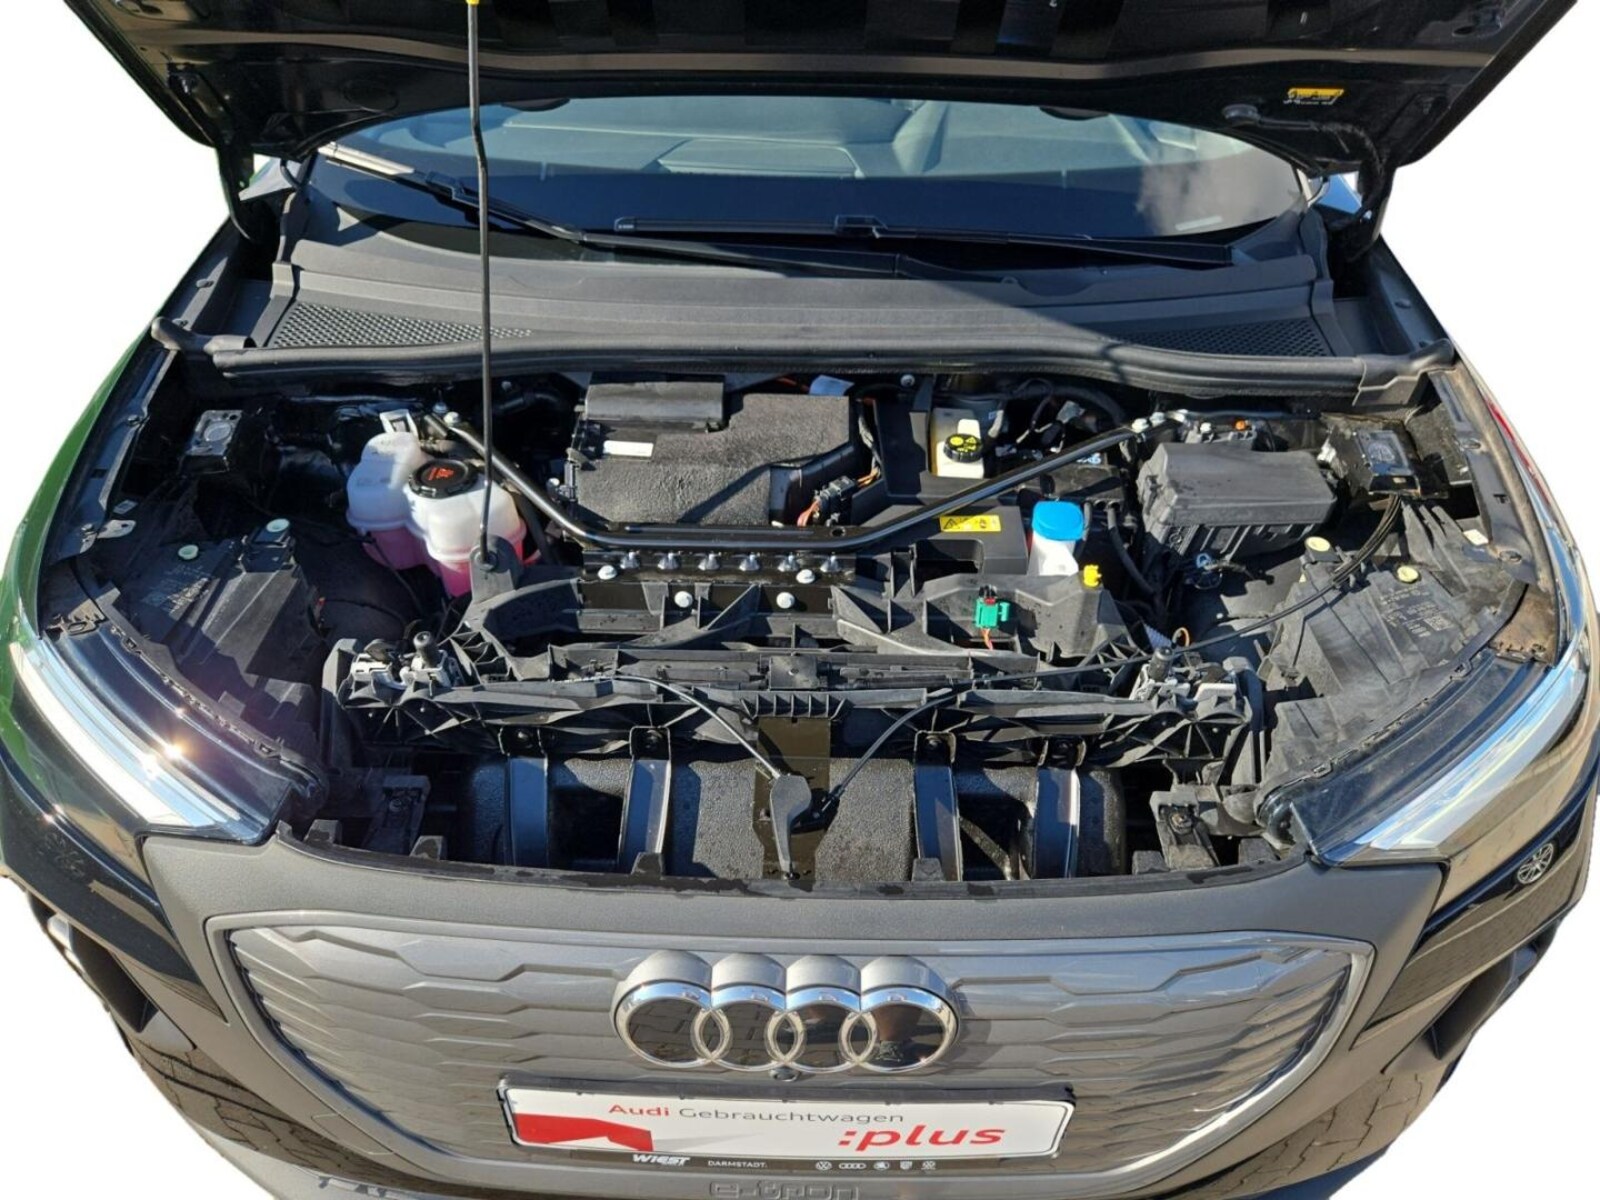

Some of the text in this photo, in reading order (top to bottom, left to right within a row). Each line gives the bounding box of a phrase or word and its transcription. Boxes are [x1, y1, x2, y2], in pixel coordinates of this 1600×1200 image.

[608, 1104, 904, 1125] Audi Gebrauchtwagen
[838, 1124, 1006, 1152] :plus
